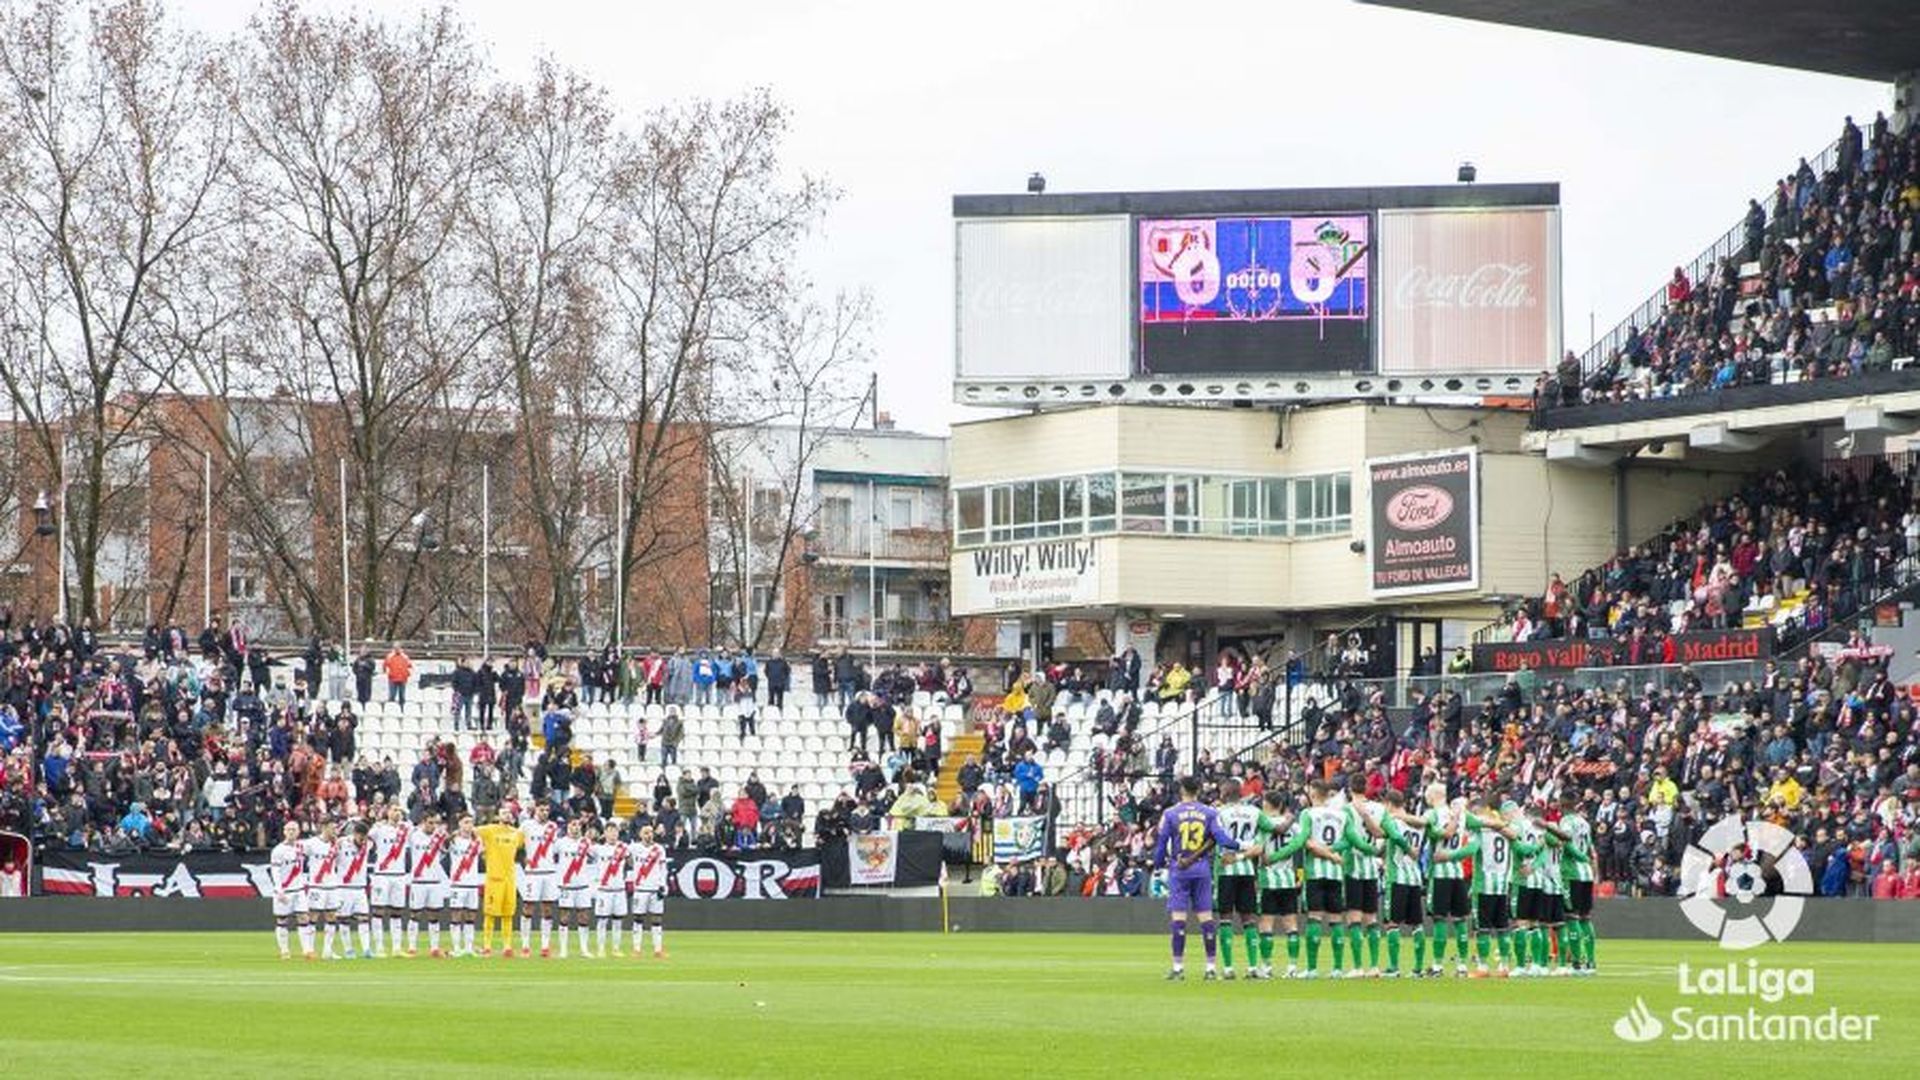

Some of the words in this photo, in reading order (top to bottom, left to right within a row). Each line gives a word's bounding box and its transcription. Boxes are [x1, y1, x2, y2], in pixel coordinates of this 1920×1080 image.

[1226, 272, 1281, 290] 00:00
[1373, 460, 1468, 481] www.almoauto.es
[1396, 492, 1440, 522] Ford
[1385, 535, 1456, 558] Almoauto
[974, 545, 1030, 579] Willy!
[1037, 541, 1095, 575] Willy!
[1388, 569, 1411, 583] FORD
[1412, 568, 1423, 581] DE
[1424, 563, 1469, 580] VALLECAS
[1683, 632, 1758, 660] Madrid
[1179, 821, 1205, 851] 13
[1322, 825, 1336, 846] 9
[1494, 836, 1505, 863] 8
